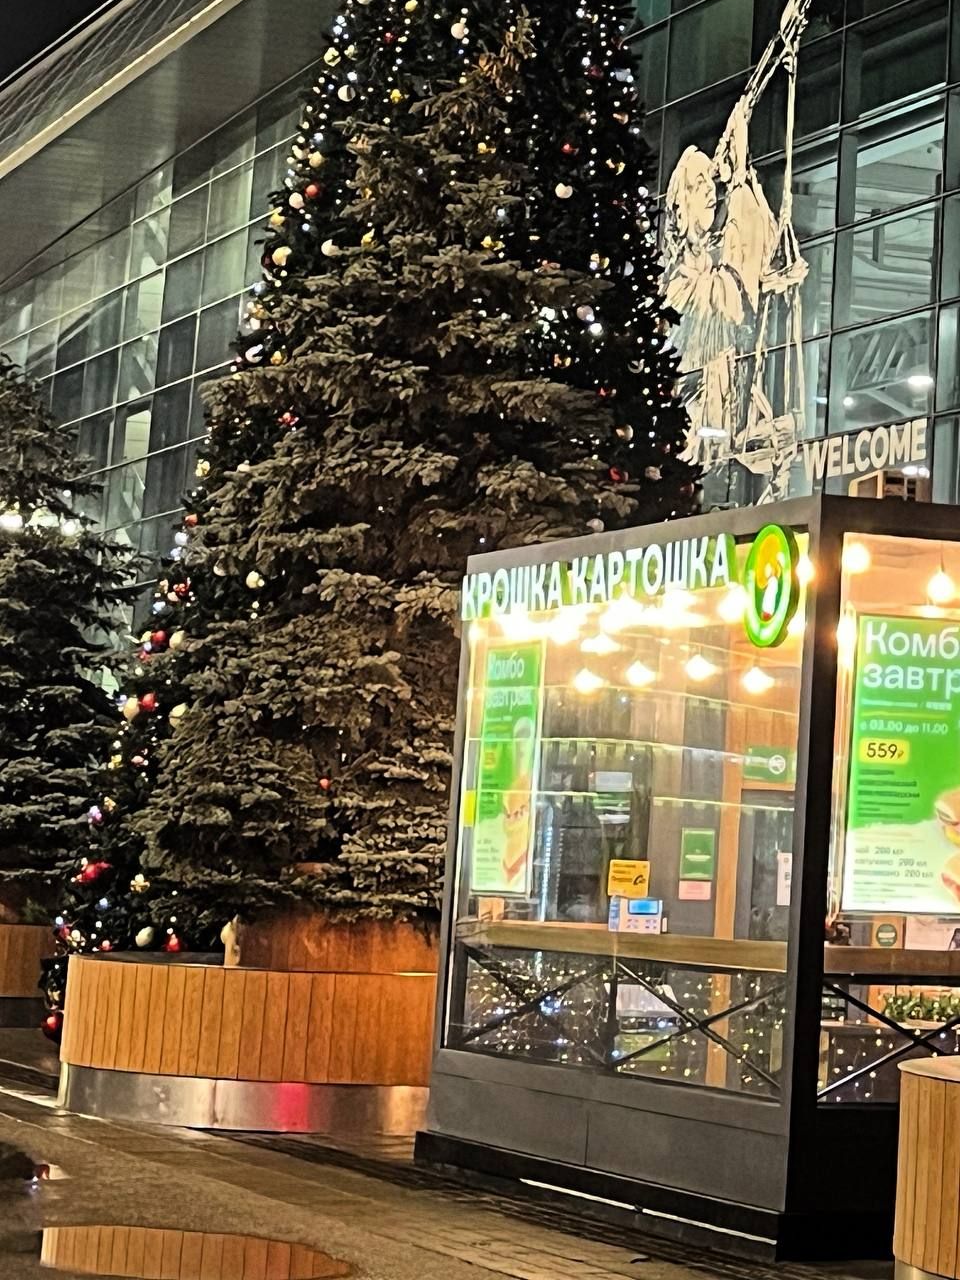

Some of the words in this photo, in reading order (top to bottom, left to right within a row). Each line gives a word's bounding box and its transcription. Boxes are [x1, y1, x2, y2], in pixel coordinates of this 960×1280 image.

[803, 418, 928, 481] WELCOME
[461, 561, 562, 621] КРОШКА
[570, 532, 730, 597] КАРТОШКА
